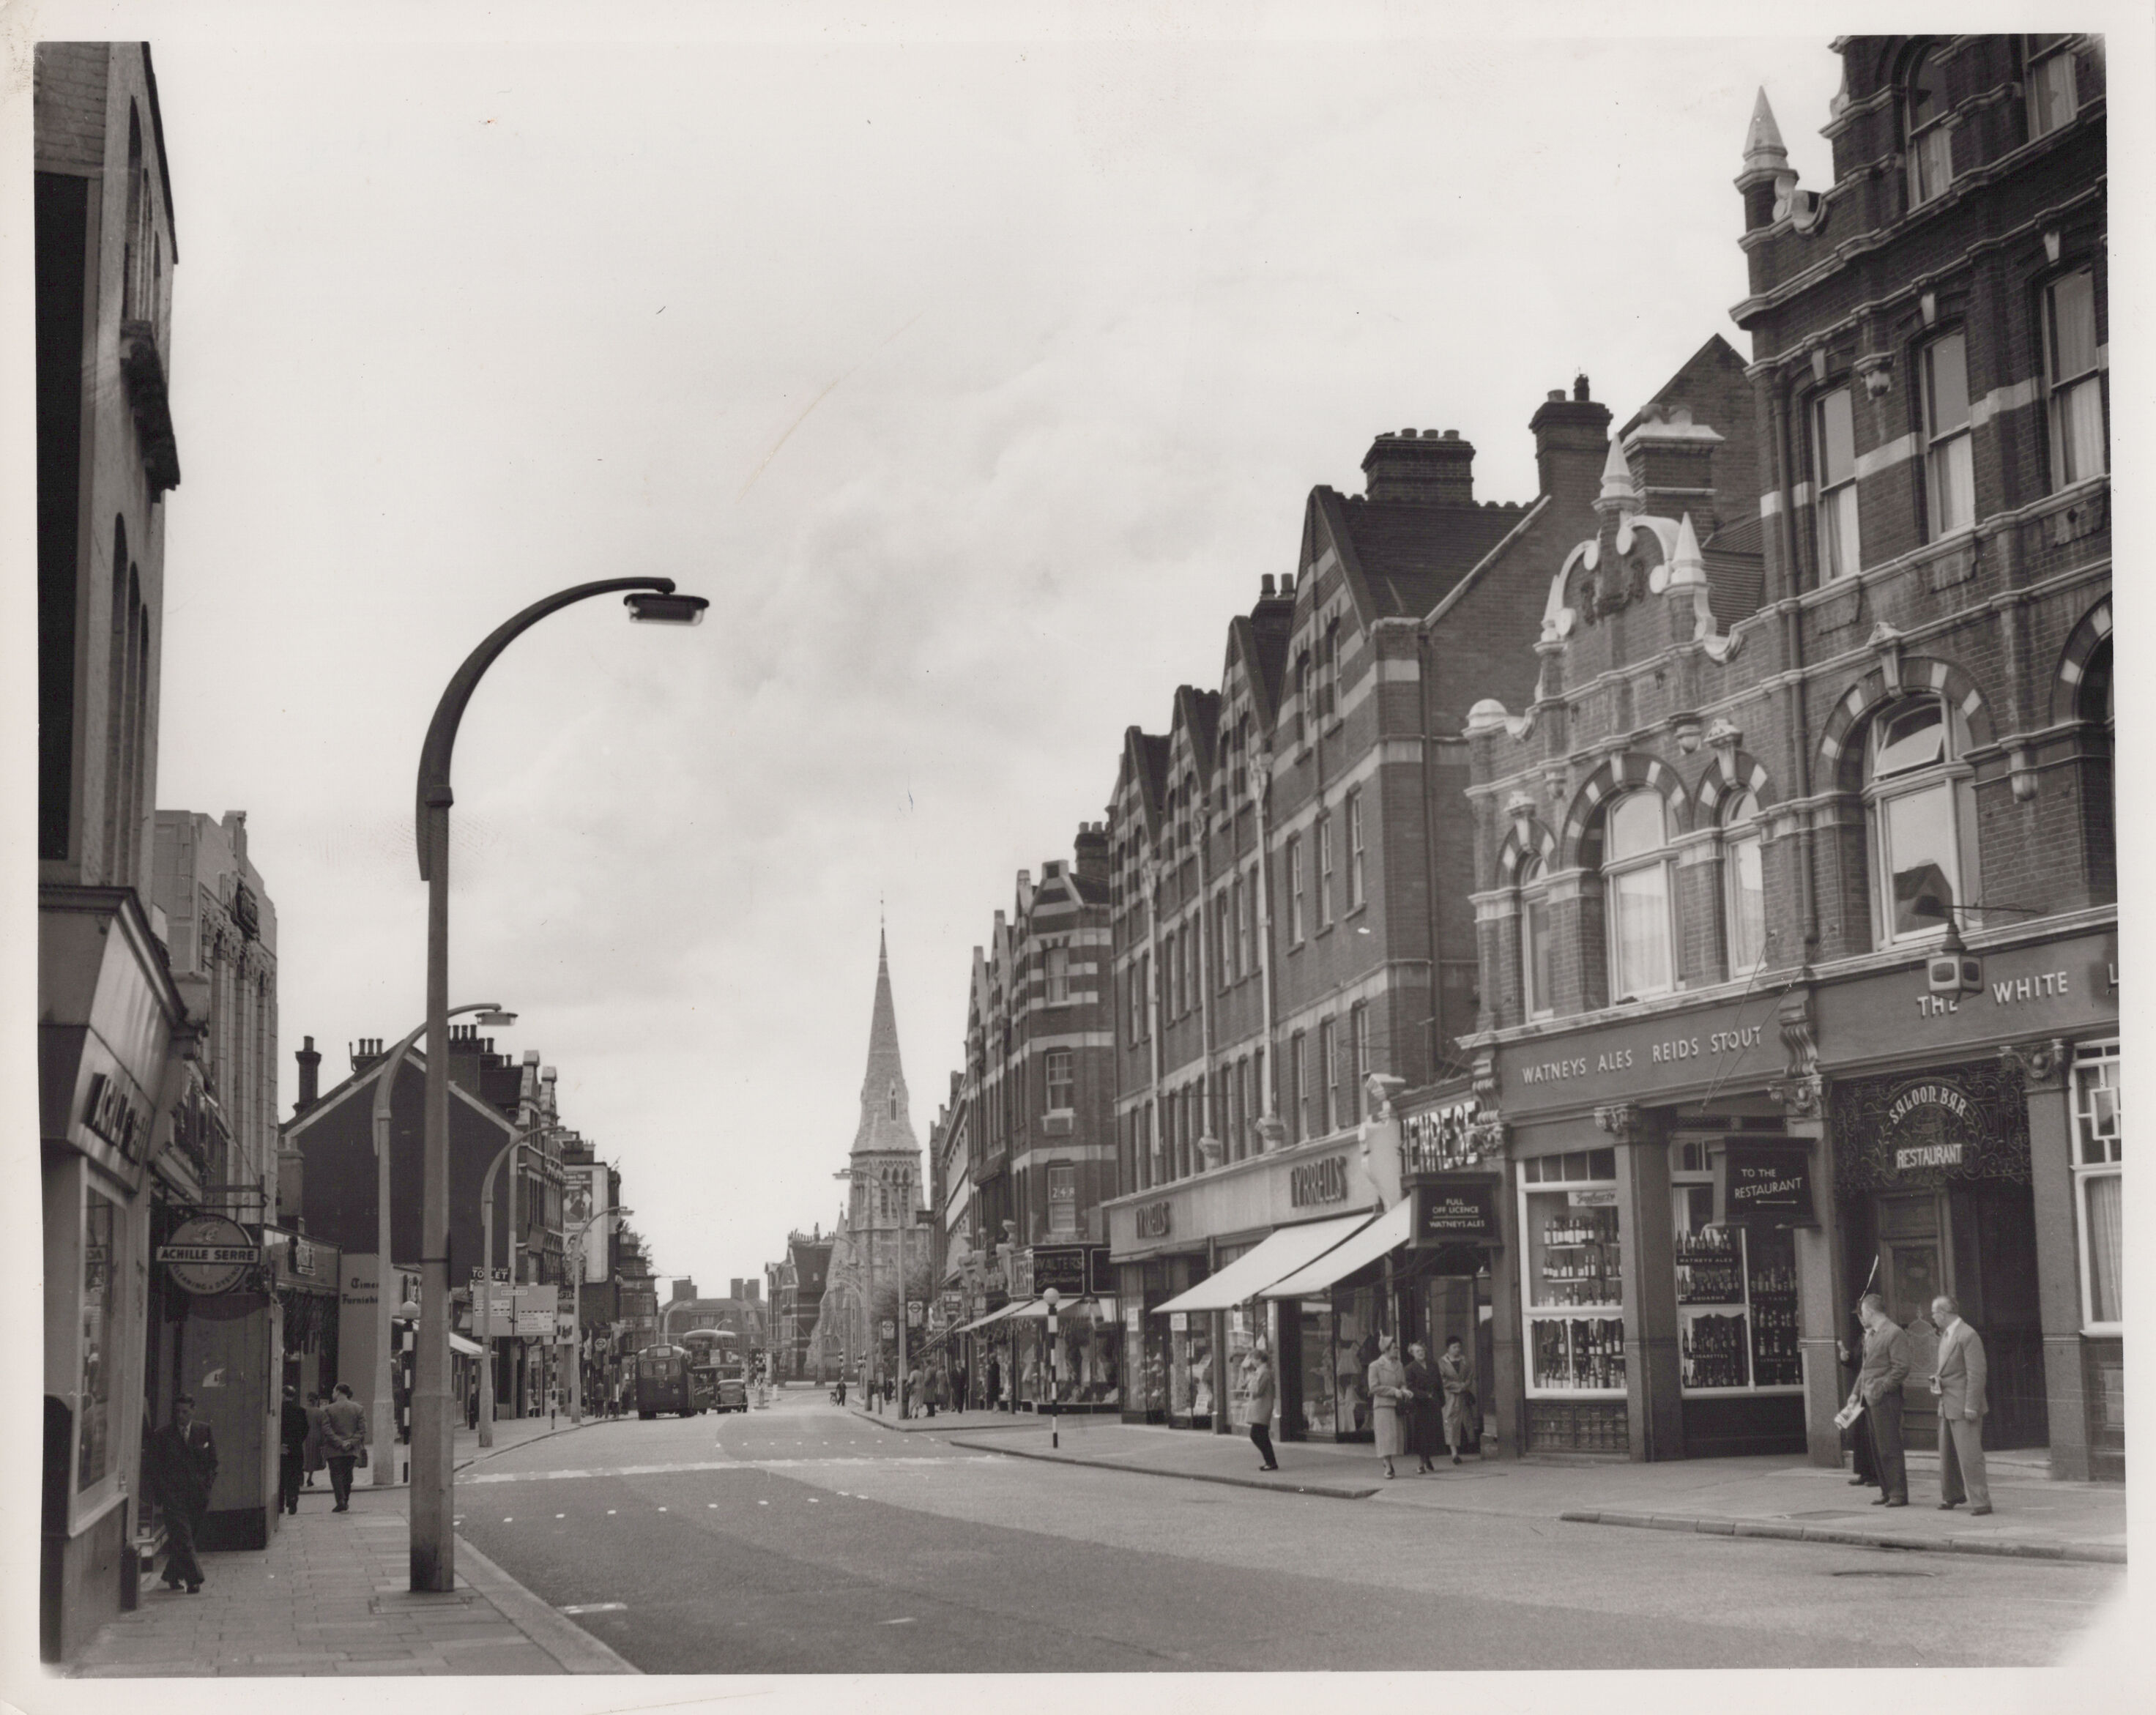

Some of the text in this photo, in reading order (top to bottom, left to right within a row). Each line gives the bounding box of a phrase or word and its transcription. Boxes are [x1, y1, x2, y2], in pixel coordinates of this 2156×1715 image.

[1992, 971, 2069, 1004] WHITE
[1522, 1026, 1761, 1084] WATNEYS ALES REIDS STOUT
[1889, 1085, 1967, 1125] SALOON BAR
[1896, 1143, 1963, 1169] RESTAURANT
[1741, 1168, 1777, 1178] TO THE
[1734, 1177, 1803, 1199] RESTAURANT
[1446, 1198, 1465, 1206] FULL
[1432, 1206, 1446, 1214] OFF
[1429, 1219, 1485, 1228] WATNEYS ALES
[160, 1249, 255, 1261] ACHILLE SERRE
[472, 1270, 484, 1279] TO
